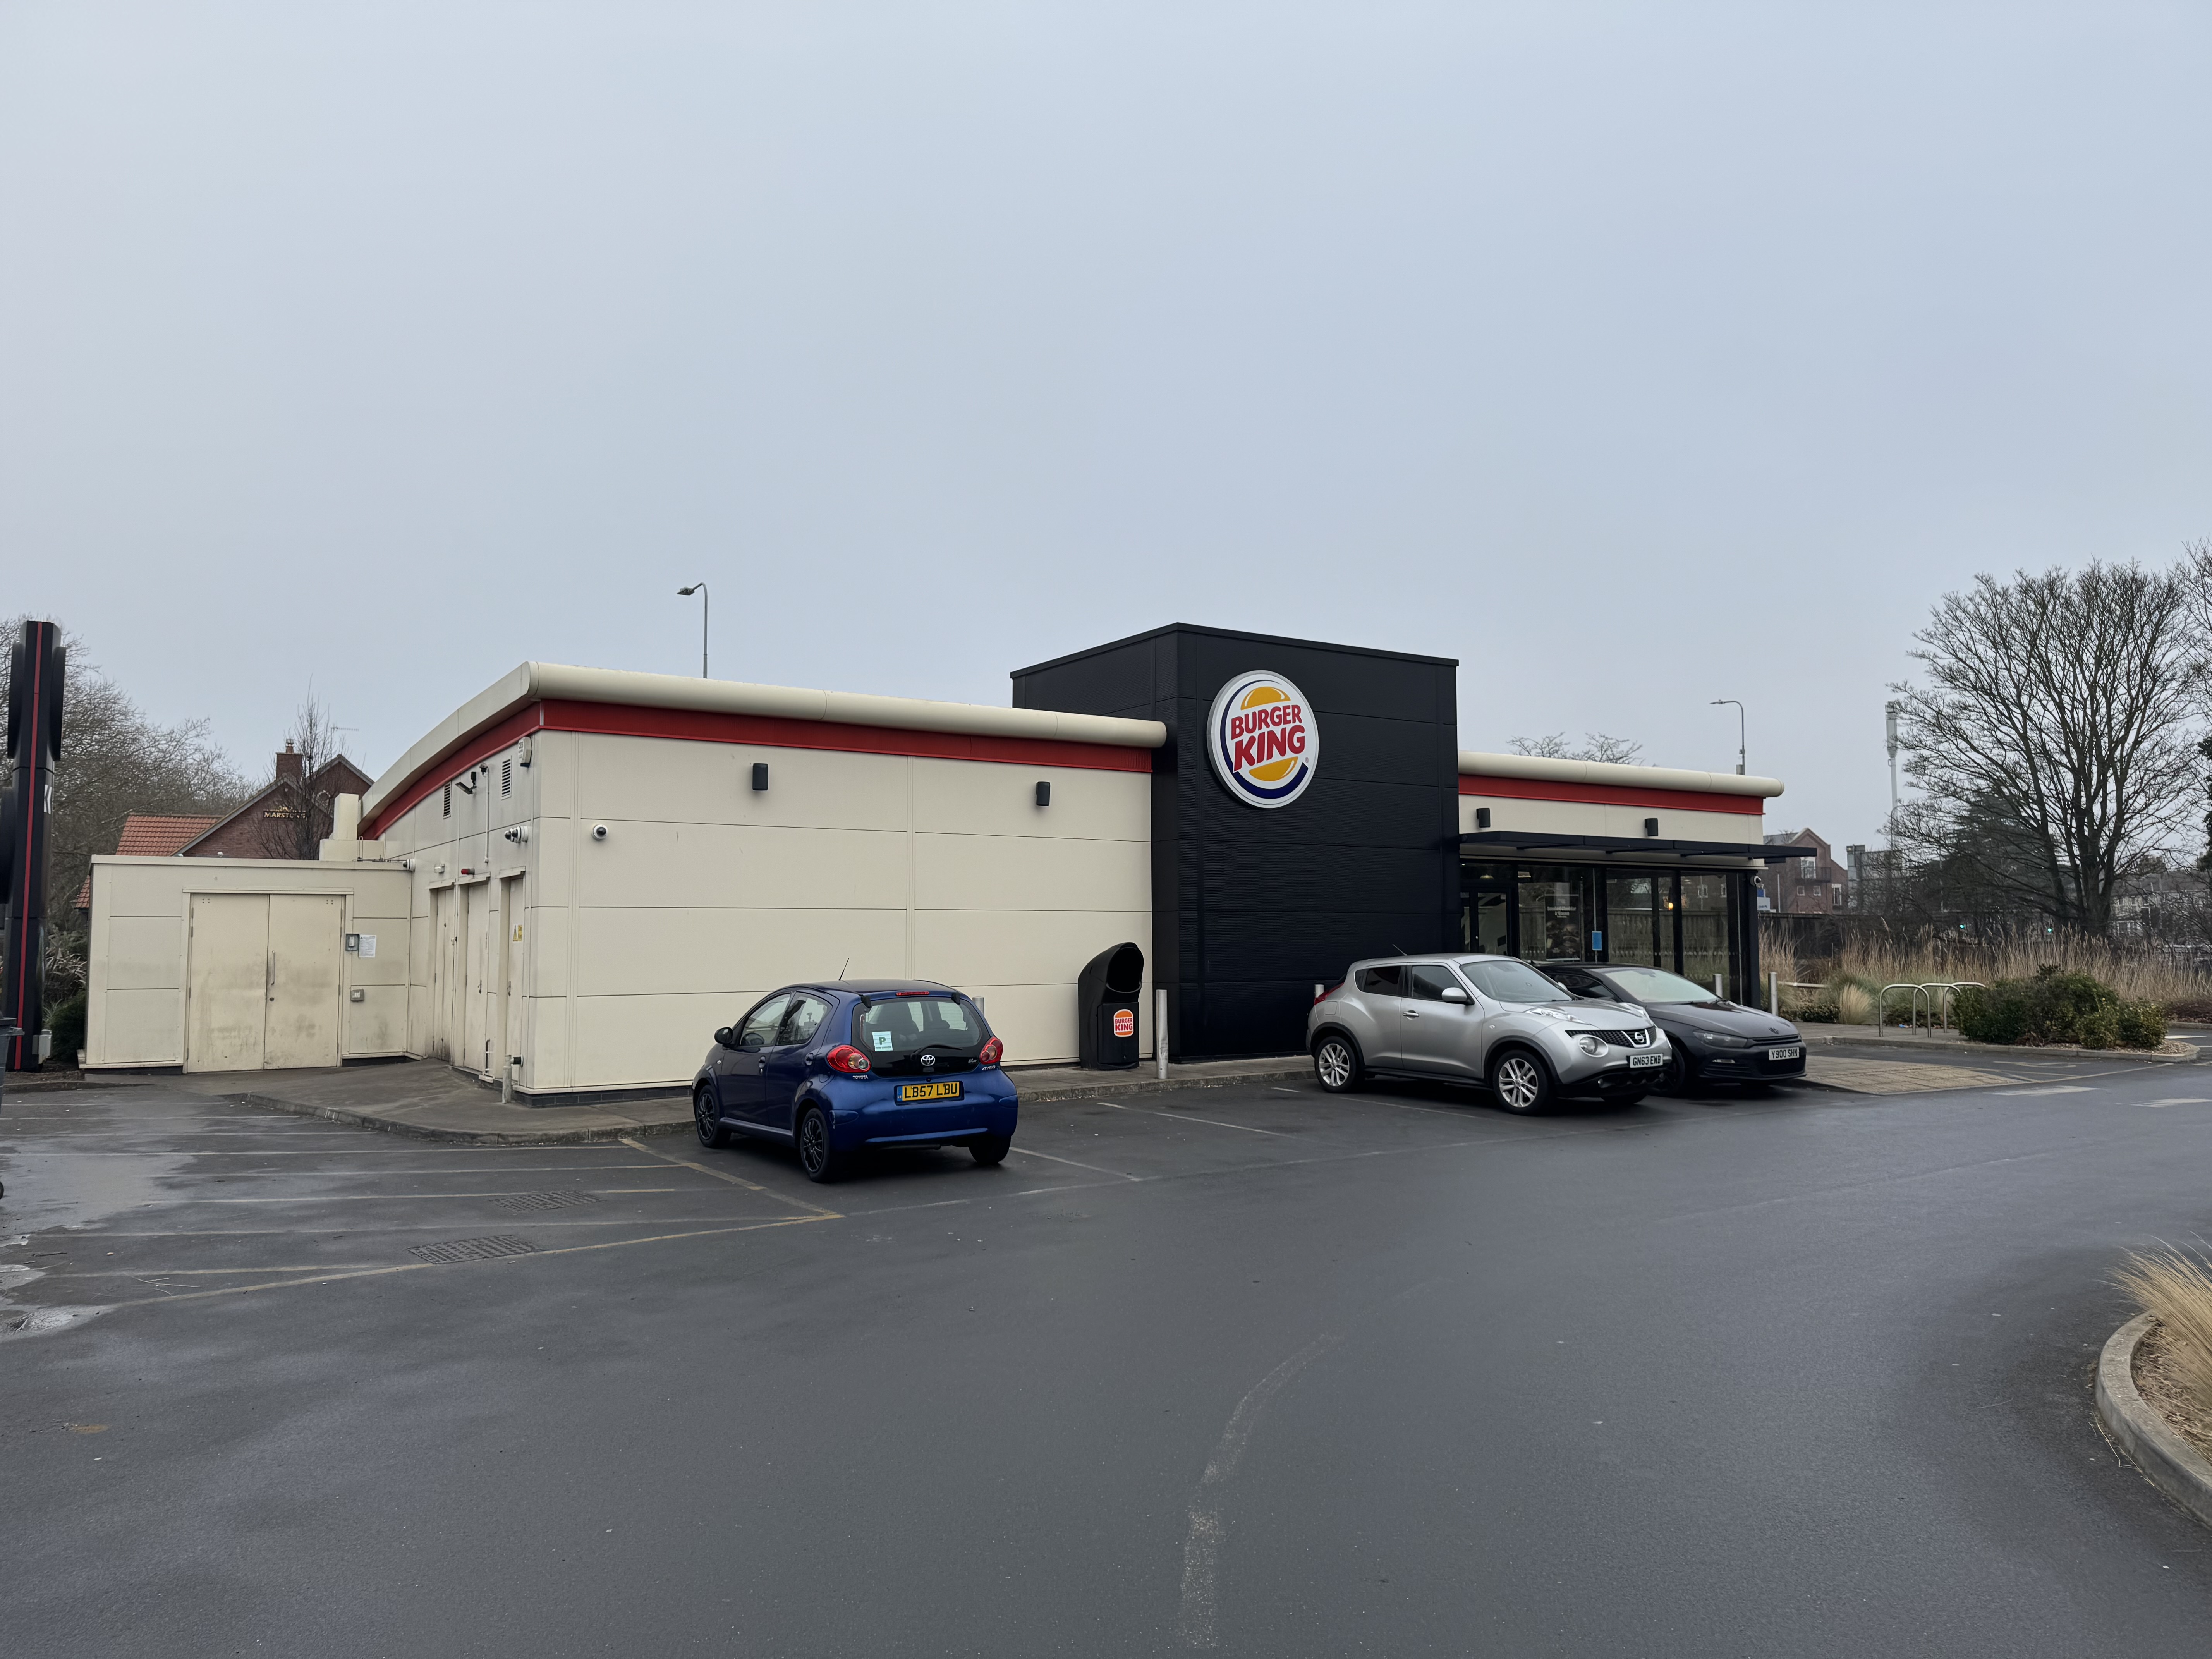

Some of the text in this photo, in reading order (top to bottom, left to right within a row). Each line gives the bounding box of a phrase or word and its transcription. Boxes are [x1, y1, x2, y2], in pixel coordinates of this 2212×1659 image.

[1231, 704, 1302, 740] BURGER
[1233, 725, 1305, 771] KING
[1115, 1023, 1133, 1031] KING
[1772, 1048, 1797, 1059] Y900 SHN
[1633, 1056, 1649, 1066] GN63
[905, 1083, 957, 1098] LB57 LBU
